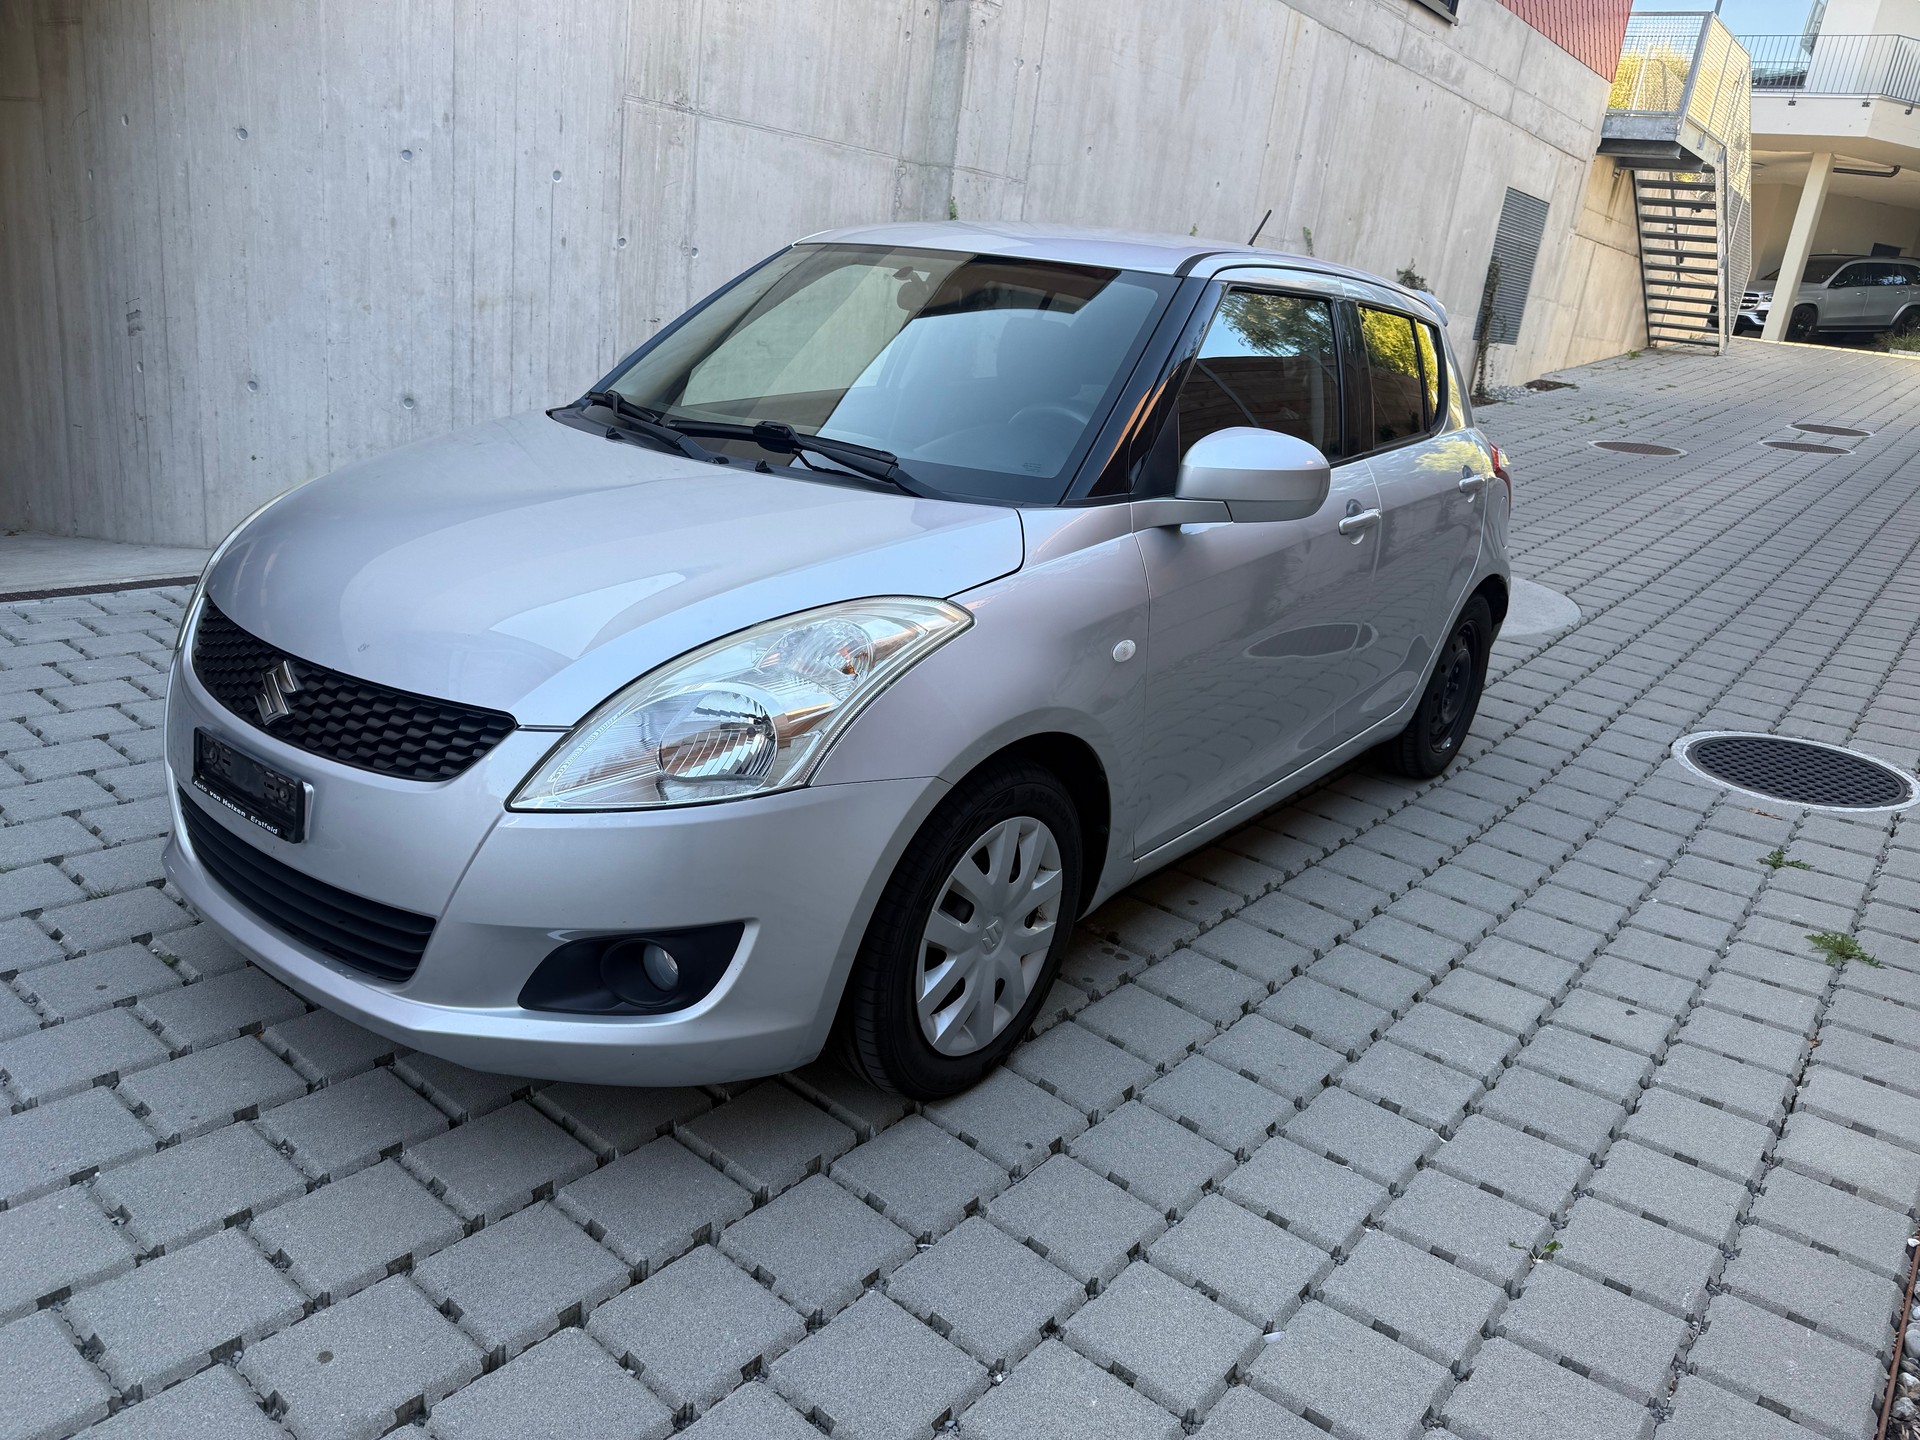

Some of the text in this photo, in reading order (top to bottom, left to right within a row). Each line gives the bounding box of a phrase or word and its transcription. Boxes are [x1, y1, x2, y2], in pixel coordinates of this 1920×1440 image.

[193, 780, 278, 835] Auto von Holzen Erstfeld
